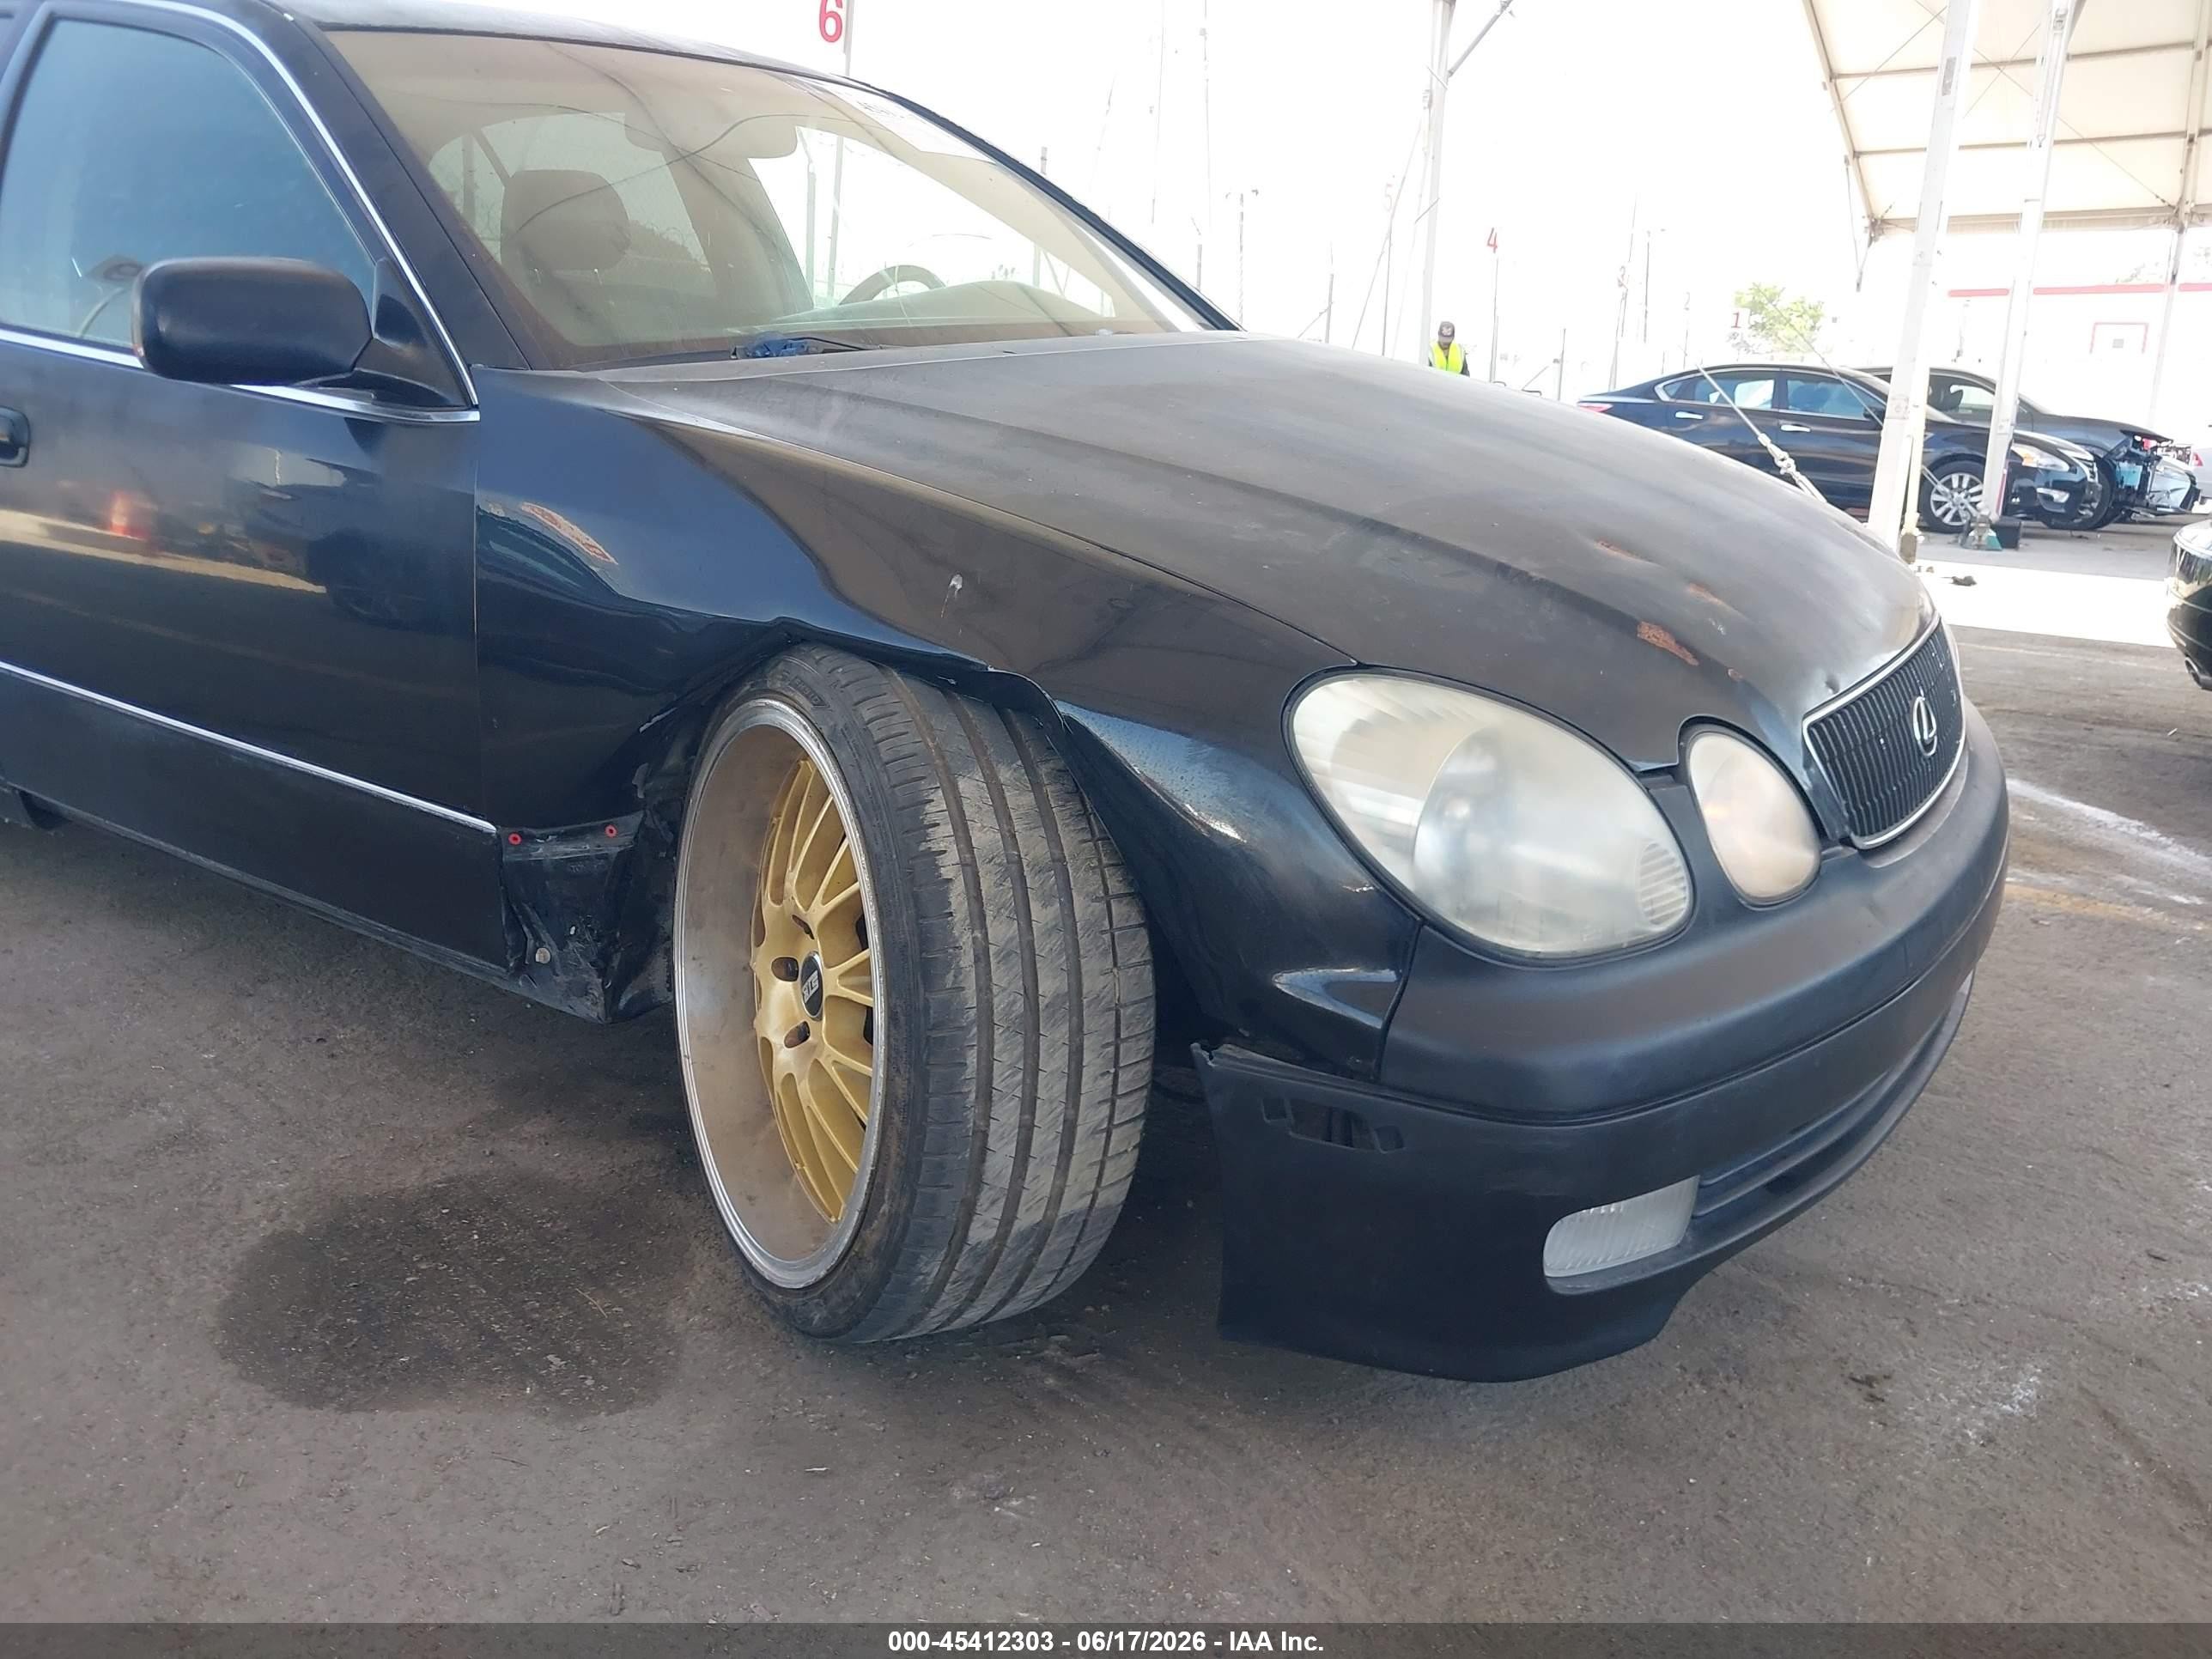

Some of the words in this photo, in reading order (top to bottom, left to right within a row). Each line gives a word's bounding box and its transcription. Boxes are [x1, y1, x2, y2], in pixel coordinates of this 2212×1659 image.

[818, 0, 843, 43] 6
[1486, 227, 1498, 254] 4
[1730, 311, 1741, 329] 1
